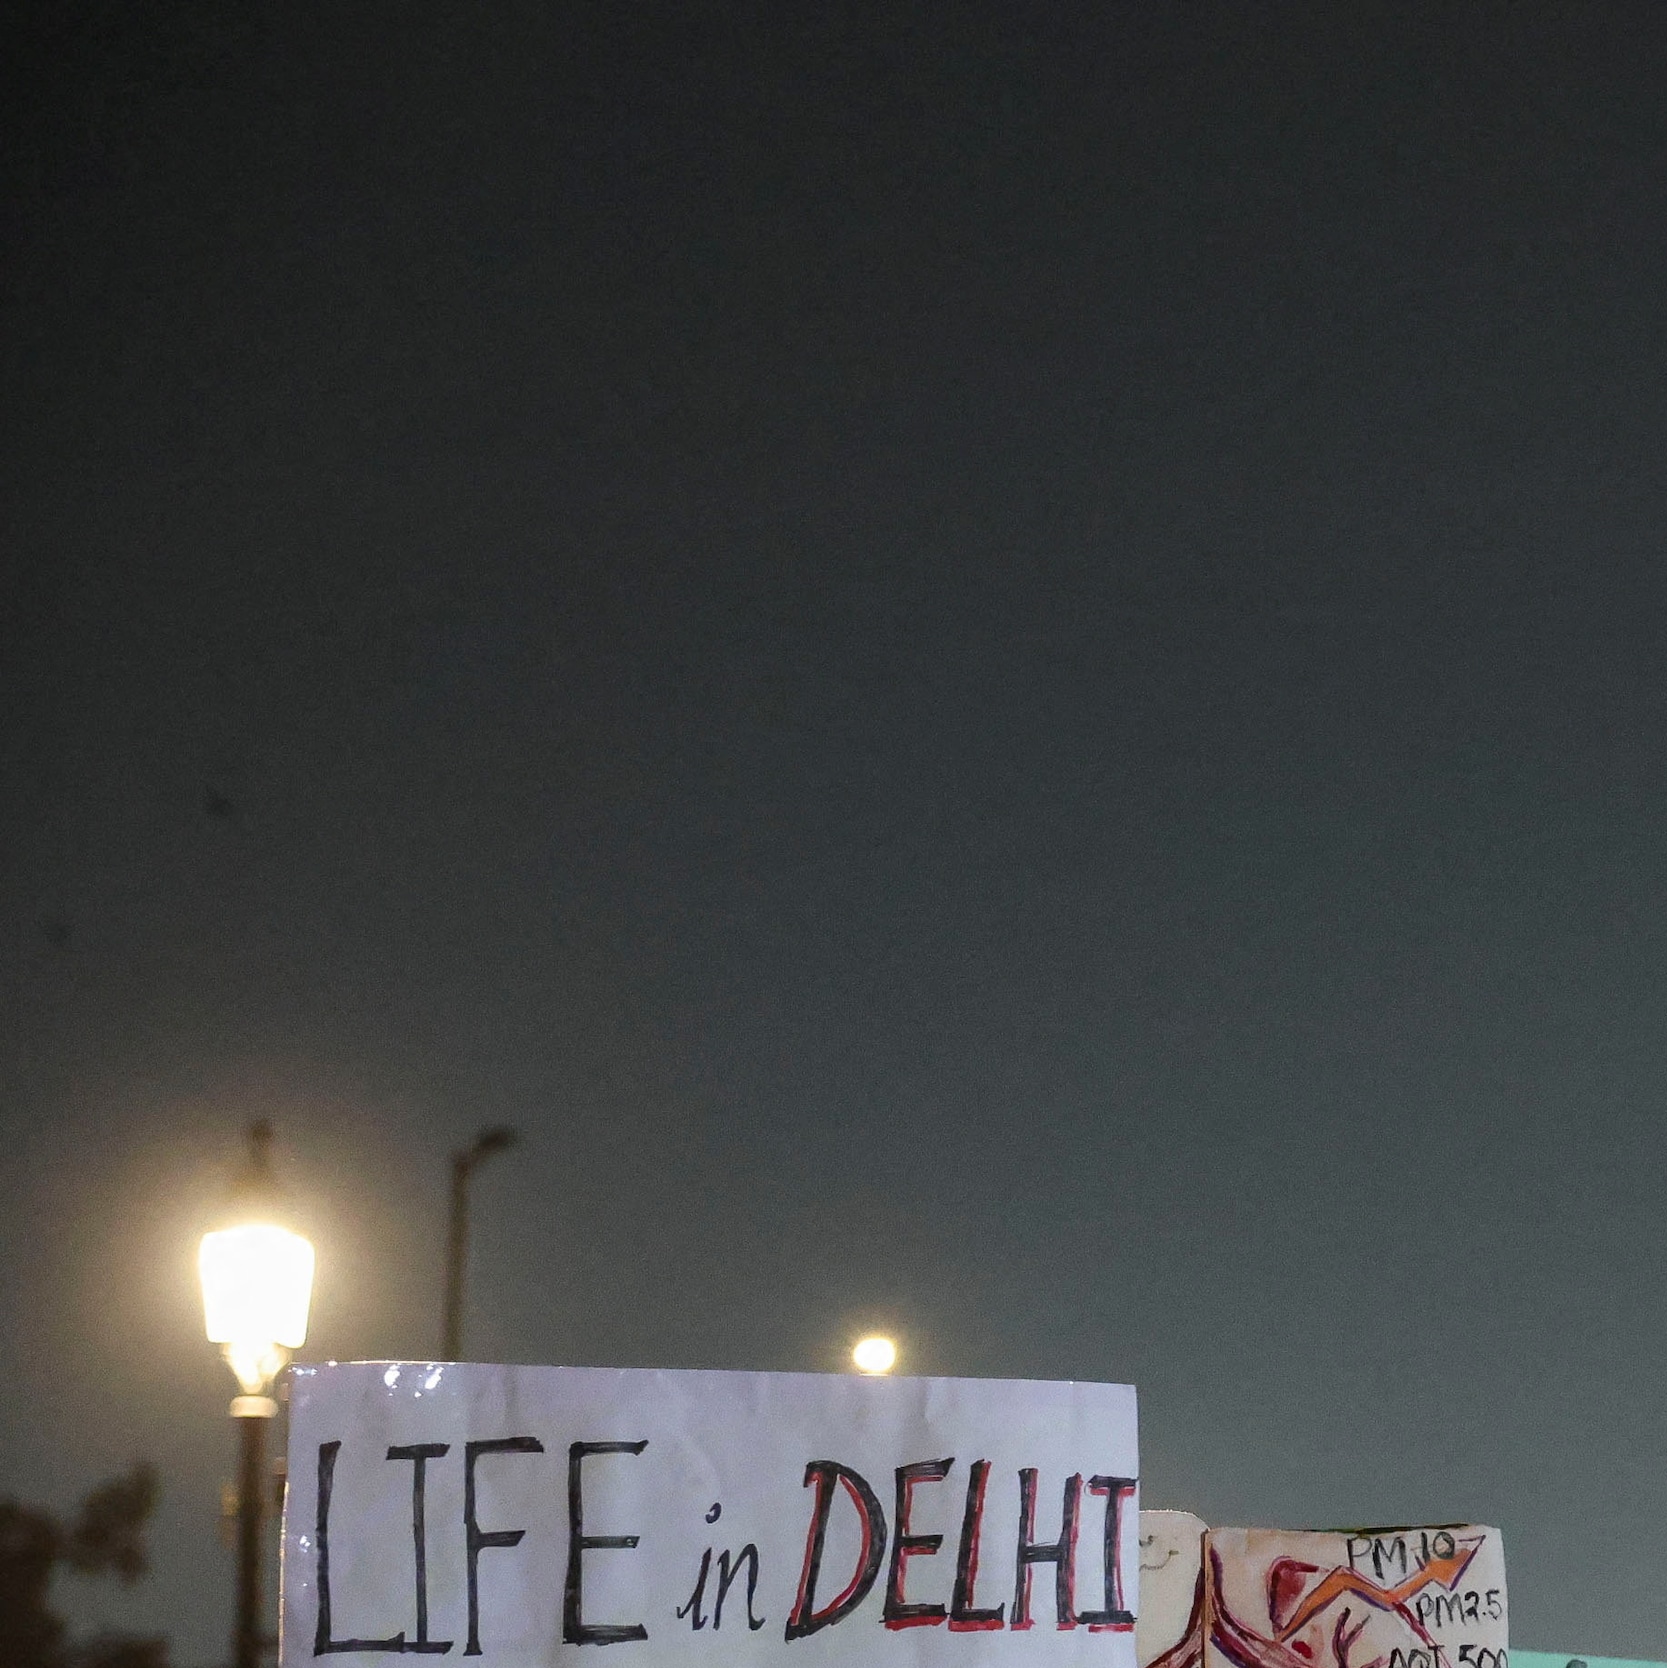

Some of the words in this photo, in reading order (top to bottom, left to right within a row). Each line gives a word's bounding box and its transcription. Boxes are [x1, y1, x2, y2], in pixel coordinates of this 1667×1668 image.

[312, 1437, 650, 1657] LIFE
[676, 1503, 765, 1632] in
[784, 1457, 1138, 1645] DELHI
